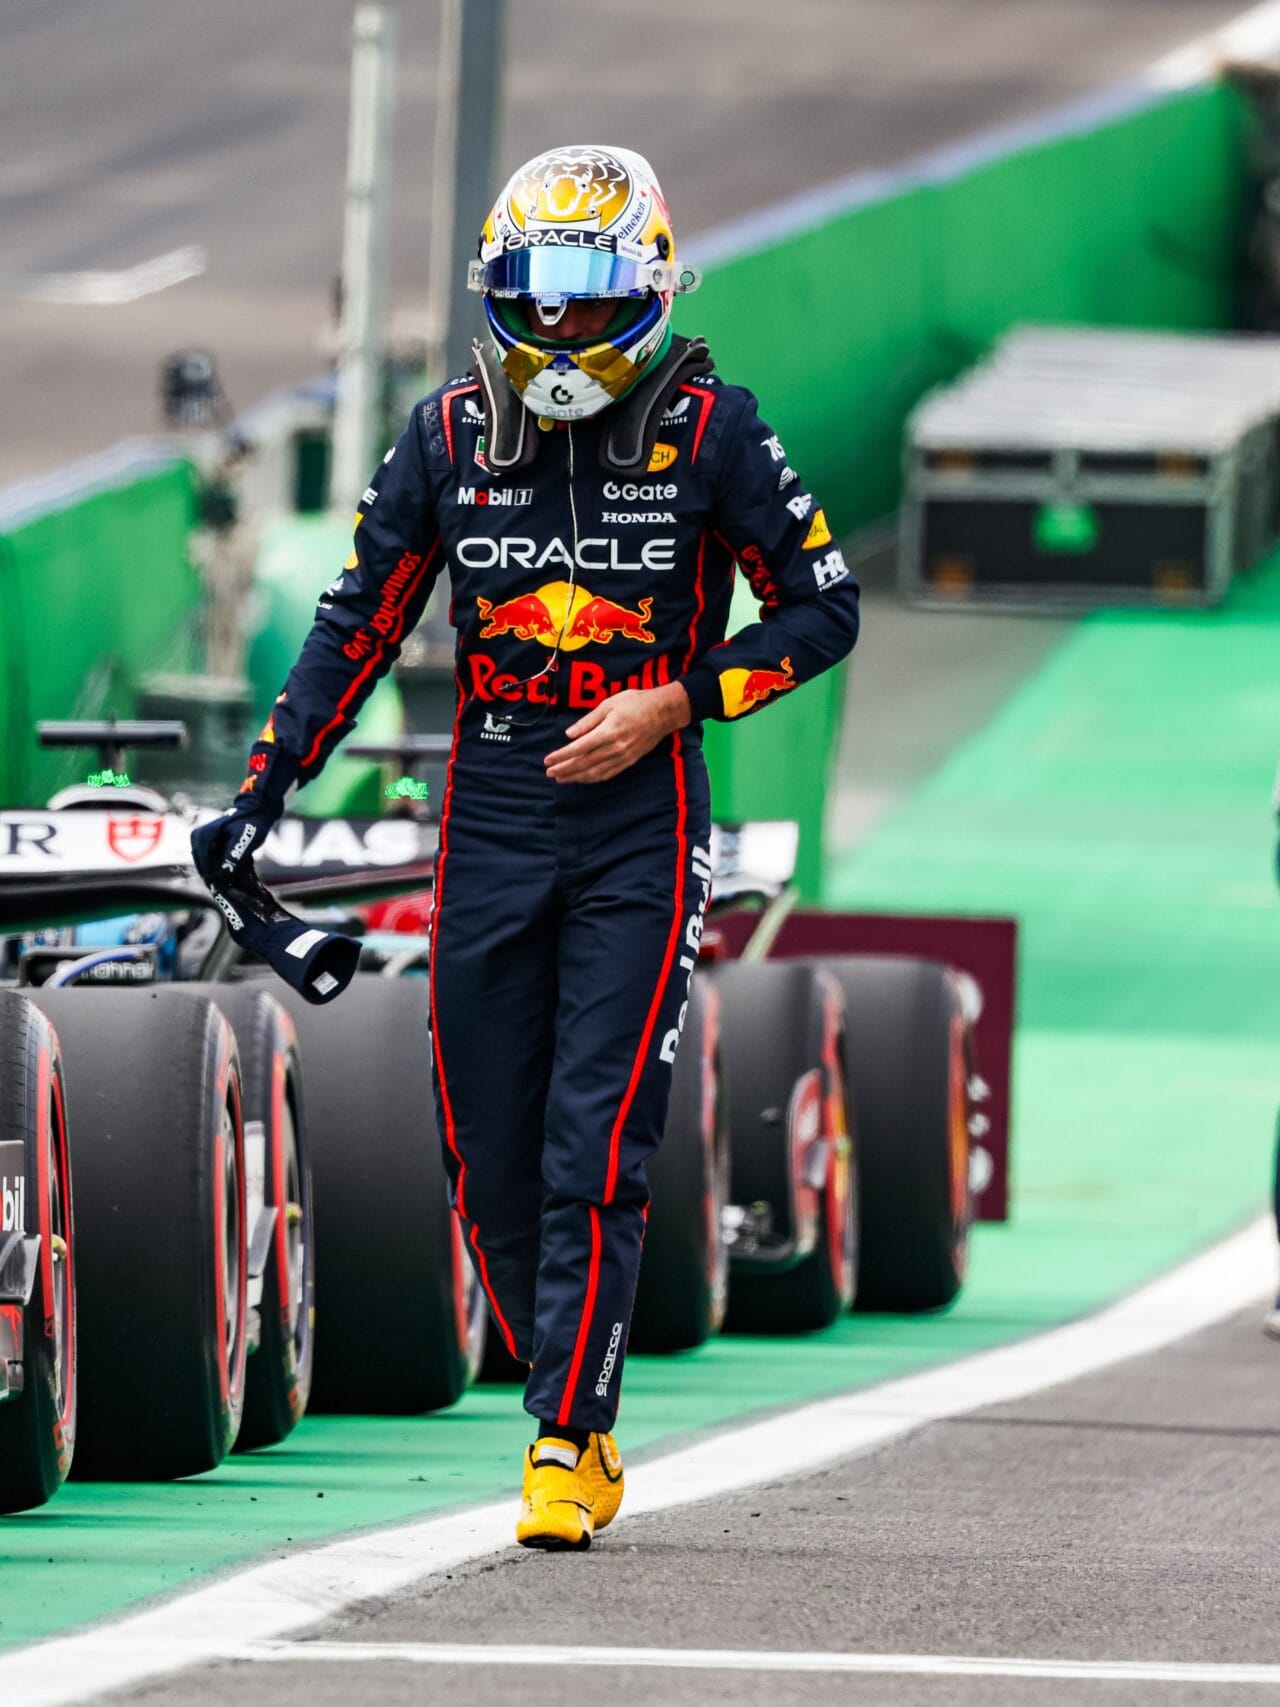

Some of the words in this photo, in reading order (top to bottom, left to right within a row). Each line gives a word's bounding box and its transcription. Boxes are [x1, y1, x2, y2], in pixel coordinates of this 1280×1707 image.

[617, 201, 646, 240] eineken
[505, 229, 614, 252] ORACLE
[544, 405, 584, 418] Gate
[457, 487, 513, 506] Mobil
[620, 483, 678, 501] Gate
[601, 511, 677, 525] HONDA
[456, 537, 677, 571] ORACLE
[468, 653, 559, 706] Red
[594, 1321, 624, 1397] sparco
